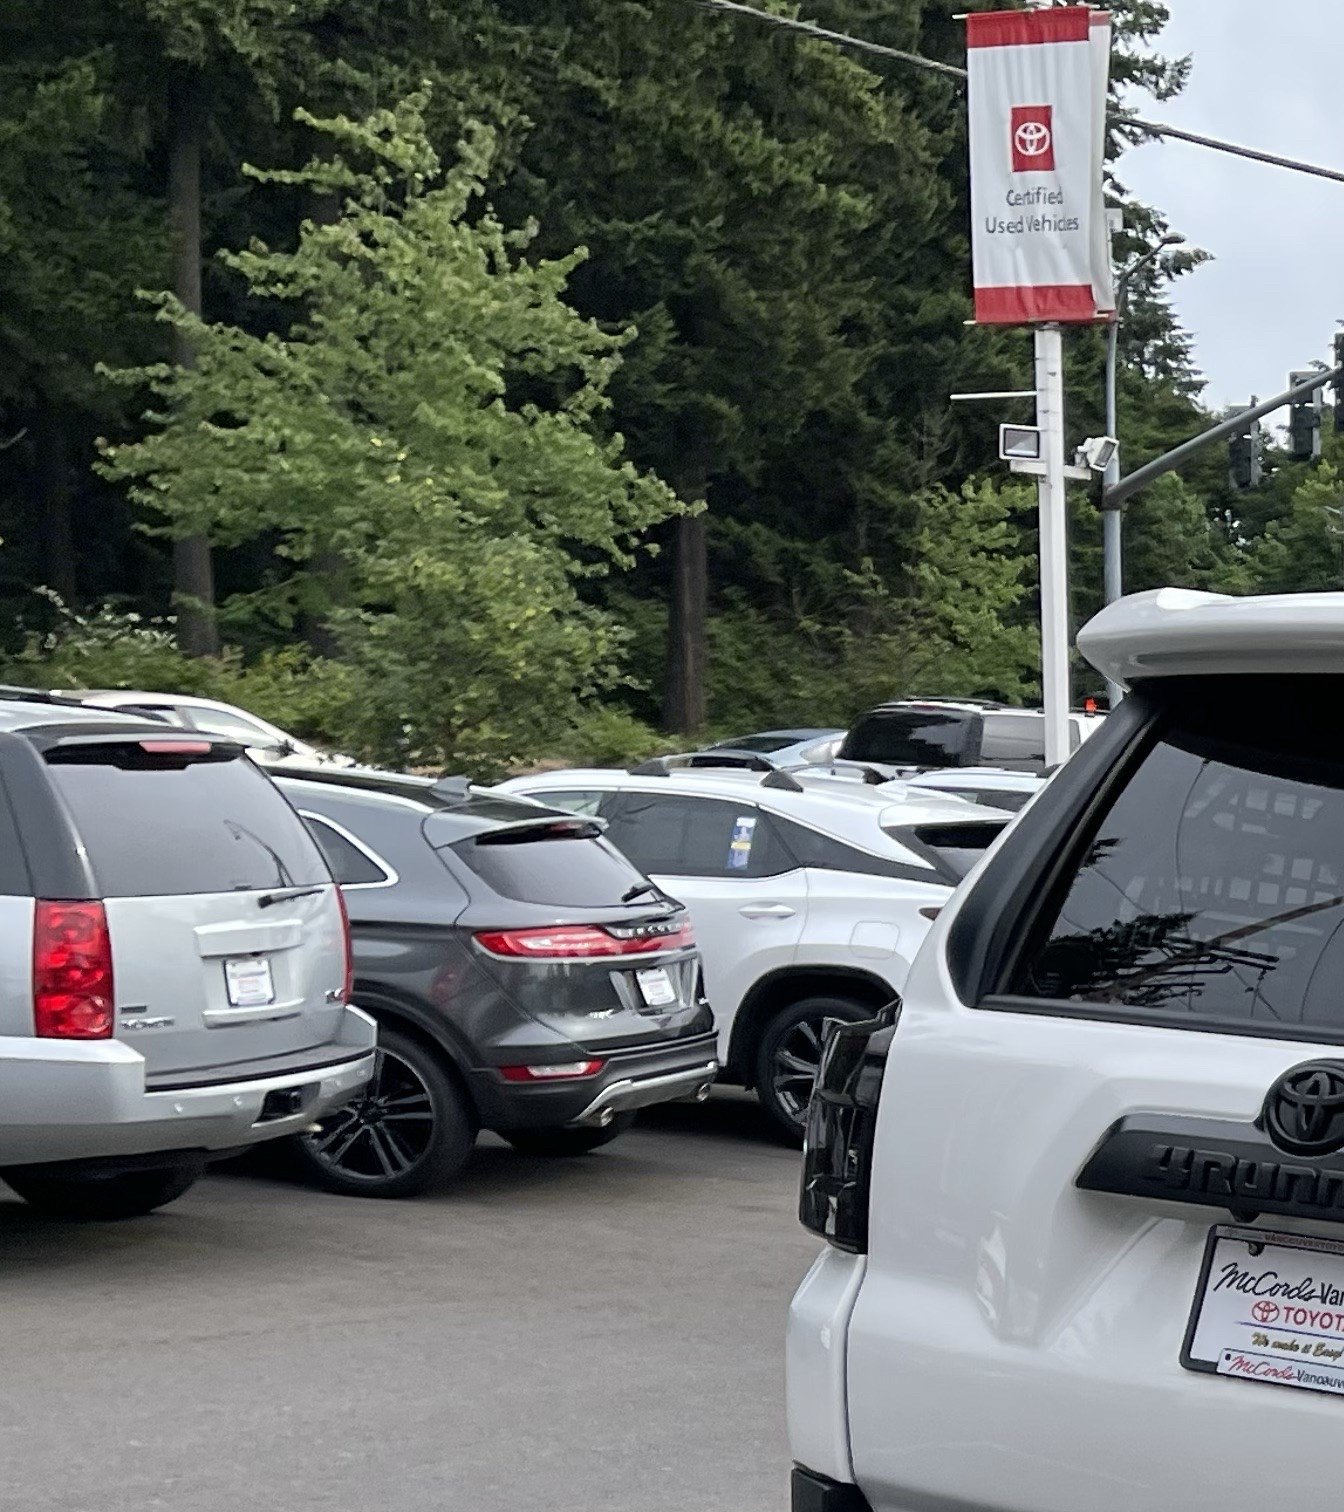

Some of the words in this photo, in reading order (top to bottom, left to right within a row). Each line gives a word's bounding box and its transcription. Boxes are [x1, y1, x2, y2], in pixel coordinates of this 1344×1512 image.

[1006, 184, 1063, 206] Certified
[985, 215, 1024, 234] Used
[1025, 213, 1079, 232] Vehicles
